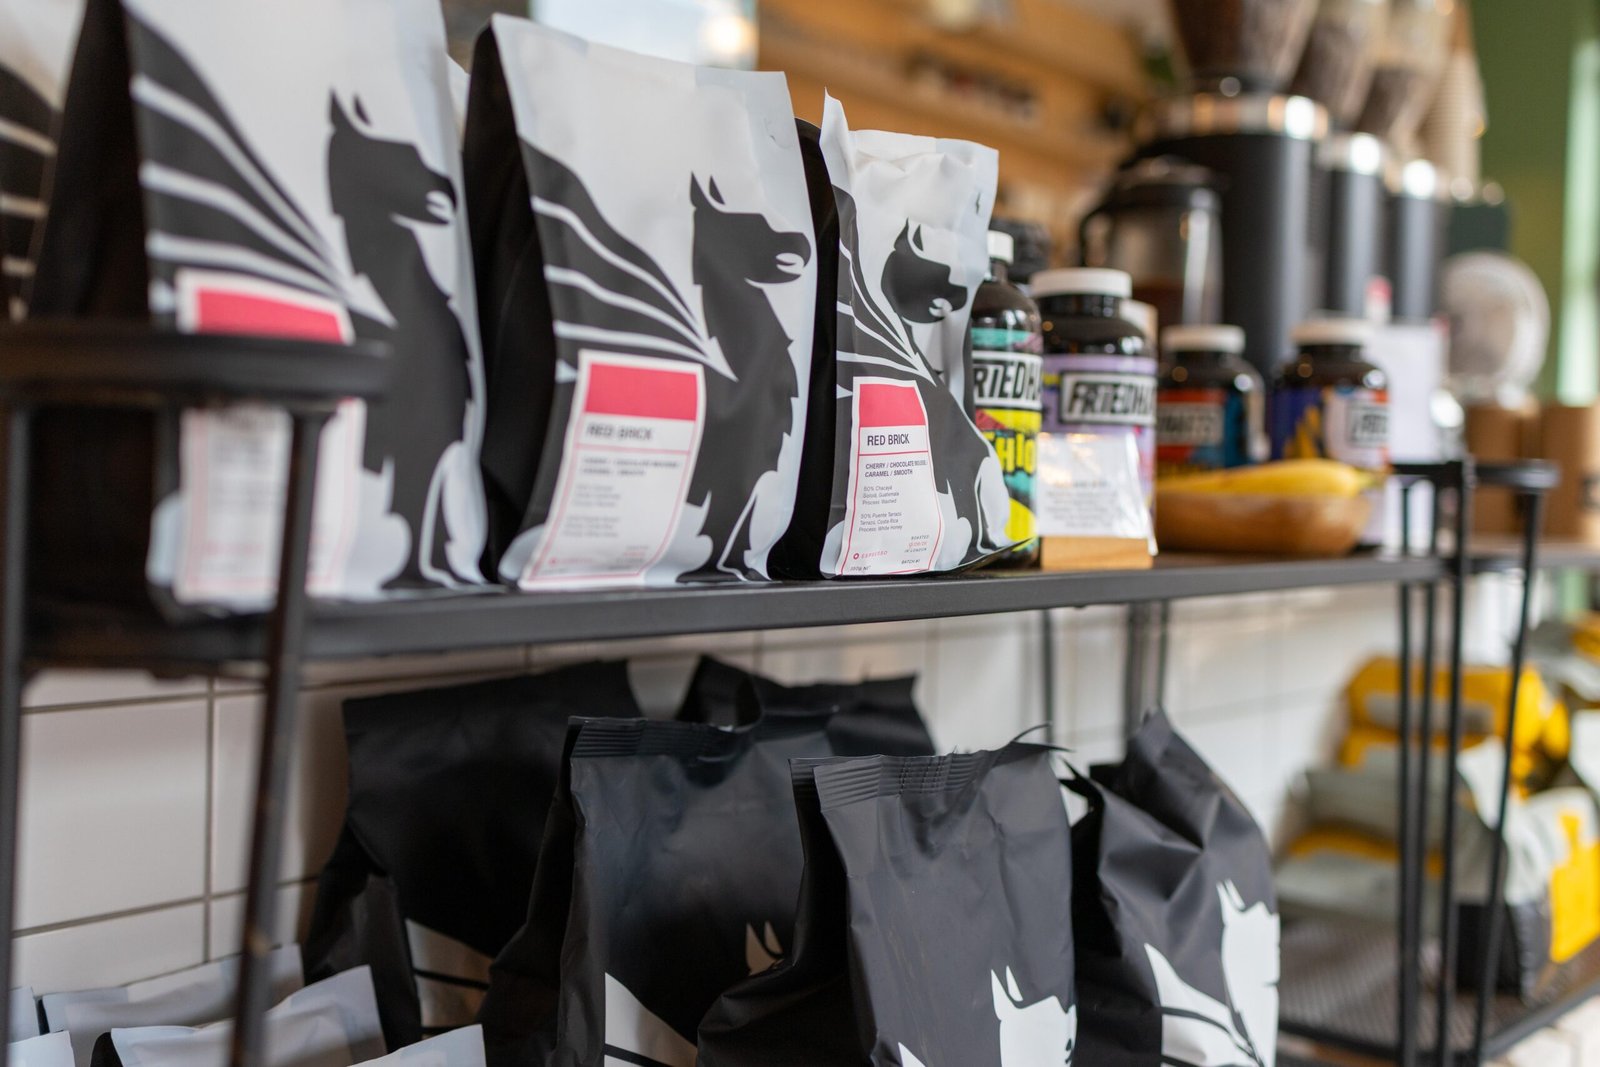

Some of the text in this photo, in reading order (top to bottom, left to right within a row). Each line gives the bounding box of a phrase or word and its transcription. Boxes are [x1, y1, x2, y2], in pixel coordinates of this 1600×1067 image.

[867, 434, 910, 446] RED BRICK
[865, 462, 886, 470] CHERRY
[889, 460, 914, 469] CHOCOLATE
[893, 469, 913, 477] SMOOTH
